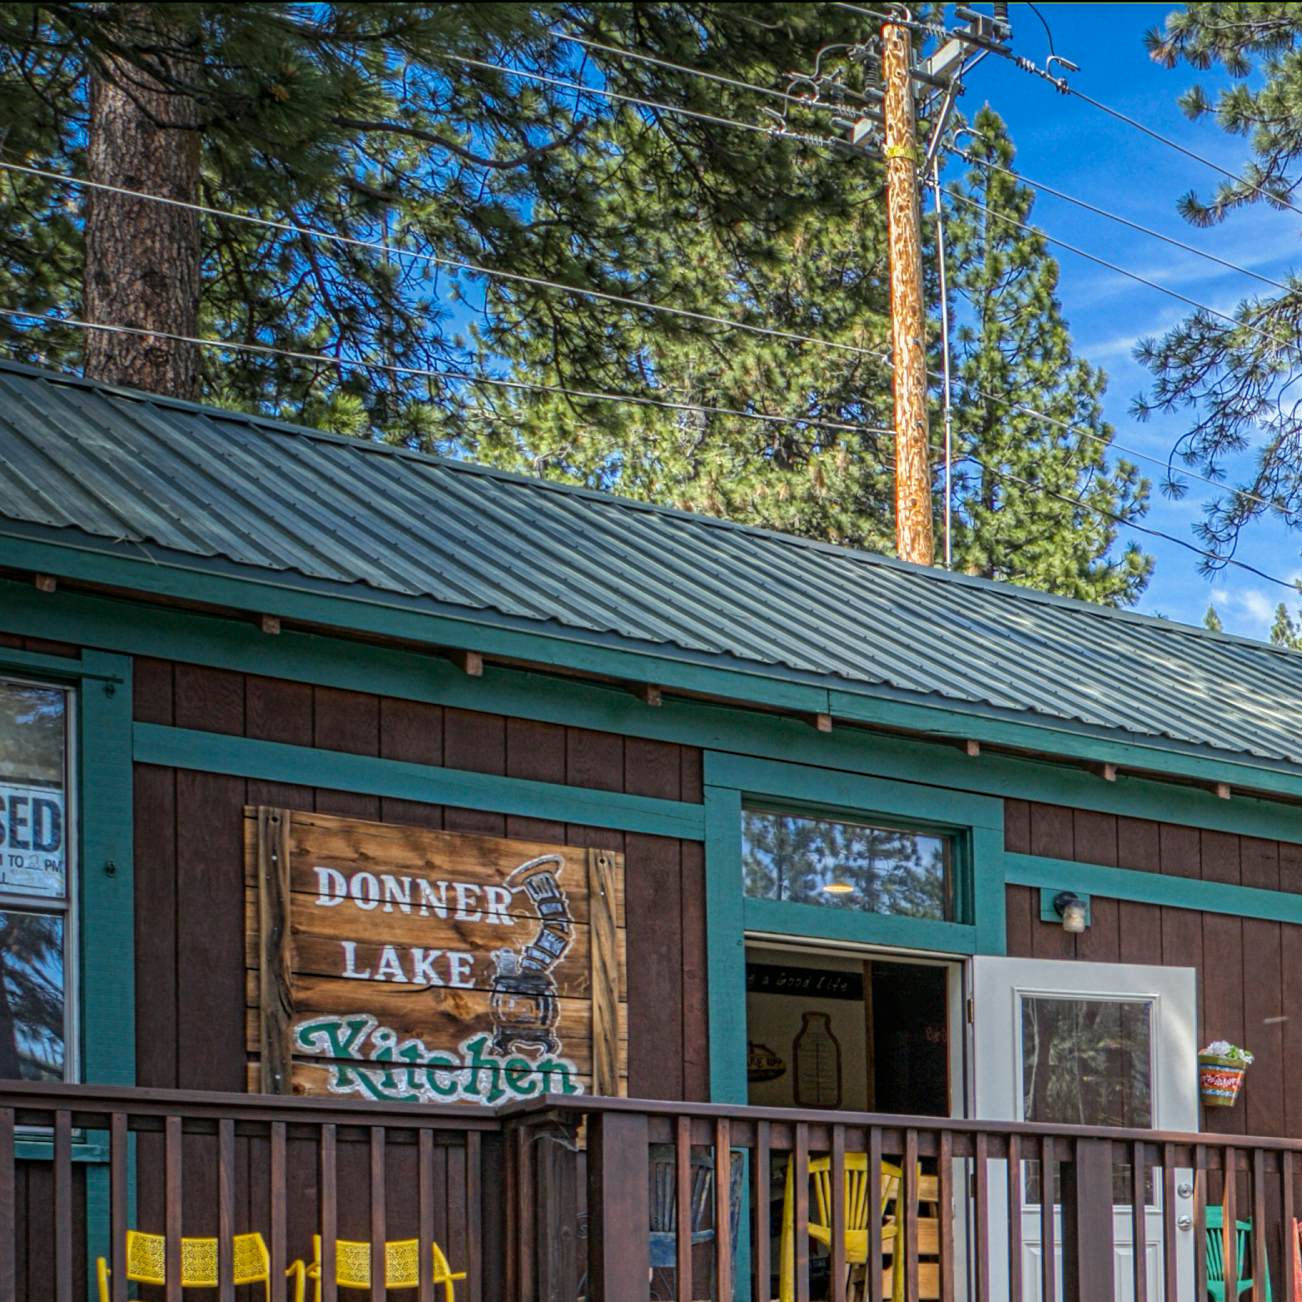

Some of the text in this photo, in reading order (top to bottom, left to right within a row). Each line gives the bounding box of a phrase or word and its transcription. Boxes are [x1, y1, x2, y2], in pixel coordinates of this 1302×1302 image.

[0, 795, 61, 852] ED
[8, 854, 24, 868] TO
[45, 859, 63, 873] PM
[313, 866, 515, 926] DONNER
[341, 941, 475, 989] LAKE
[296, 1014, 582, 1104] Kitchen
